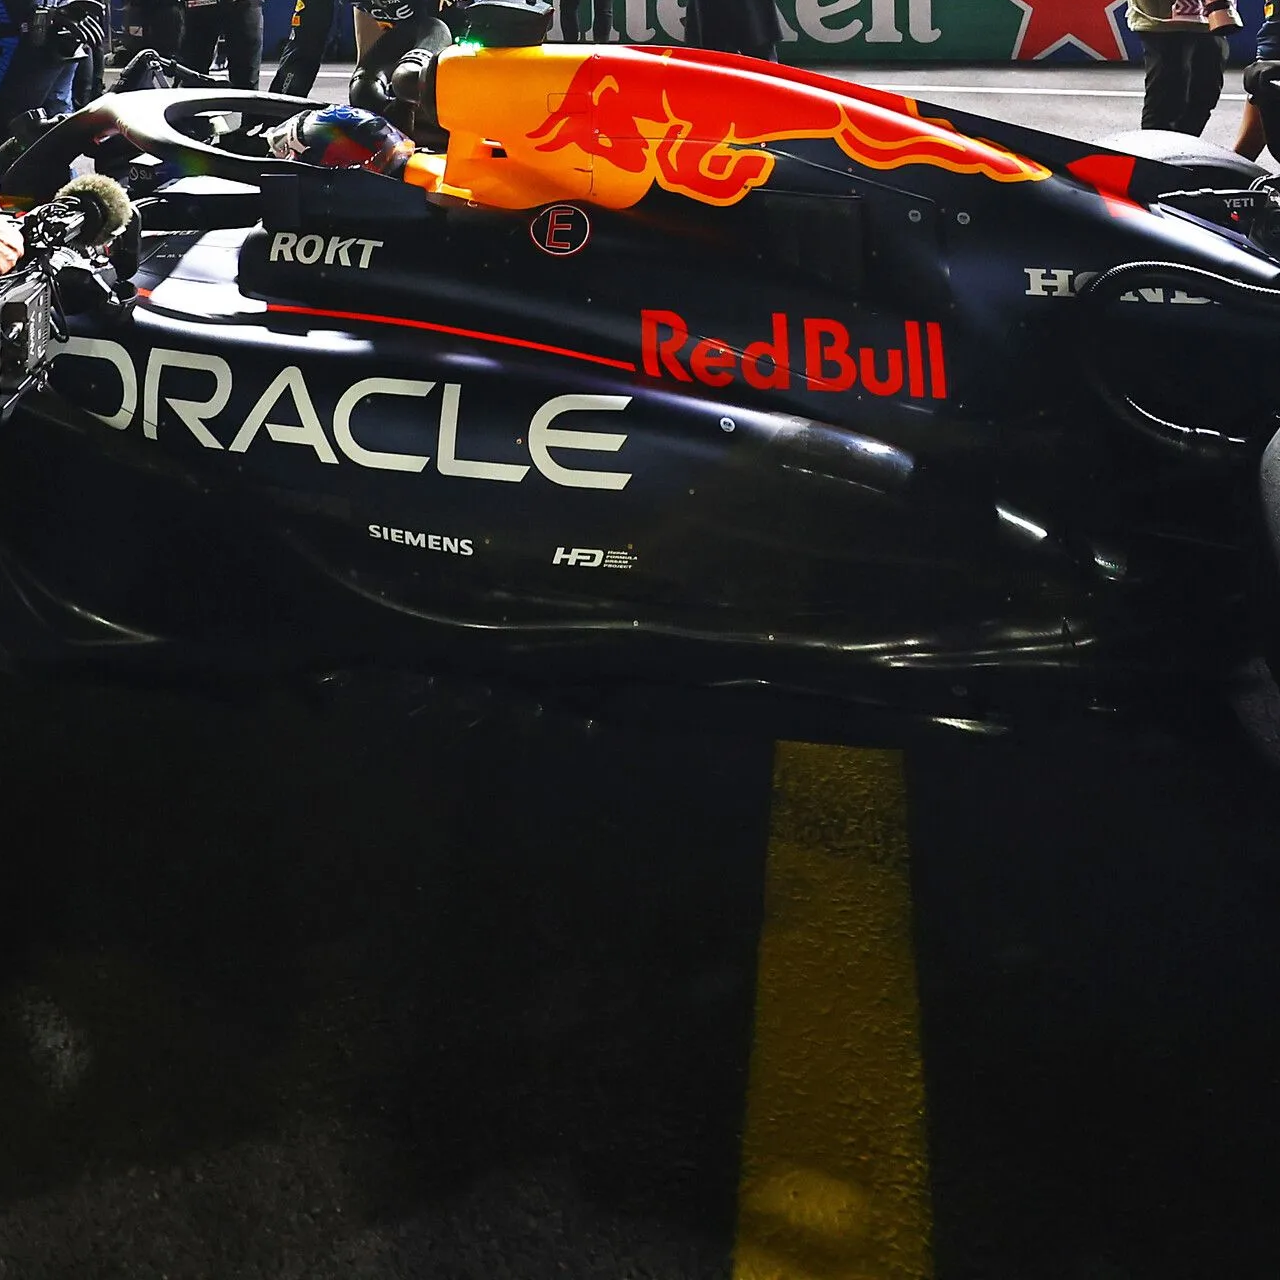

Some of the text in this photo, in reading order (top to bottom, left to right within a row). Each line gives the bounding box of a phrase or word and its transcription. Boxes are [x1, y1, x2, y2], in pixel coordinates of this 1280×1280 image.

[1223, 198, 1254, 208] YETI
[546, 204, 573, 251] E
[270, 231, 384, 269] ROKT
[640, 309, 947, 400] Red Bull
[46, 336, 634, 491] ORACLE
[368, 524, 474, 556] SIEMENS
